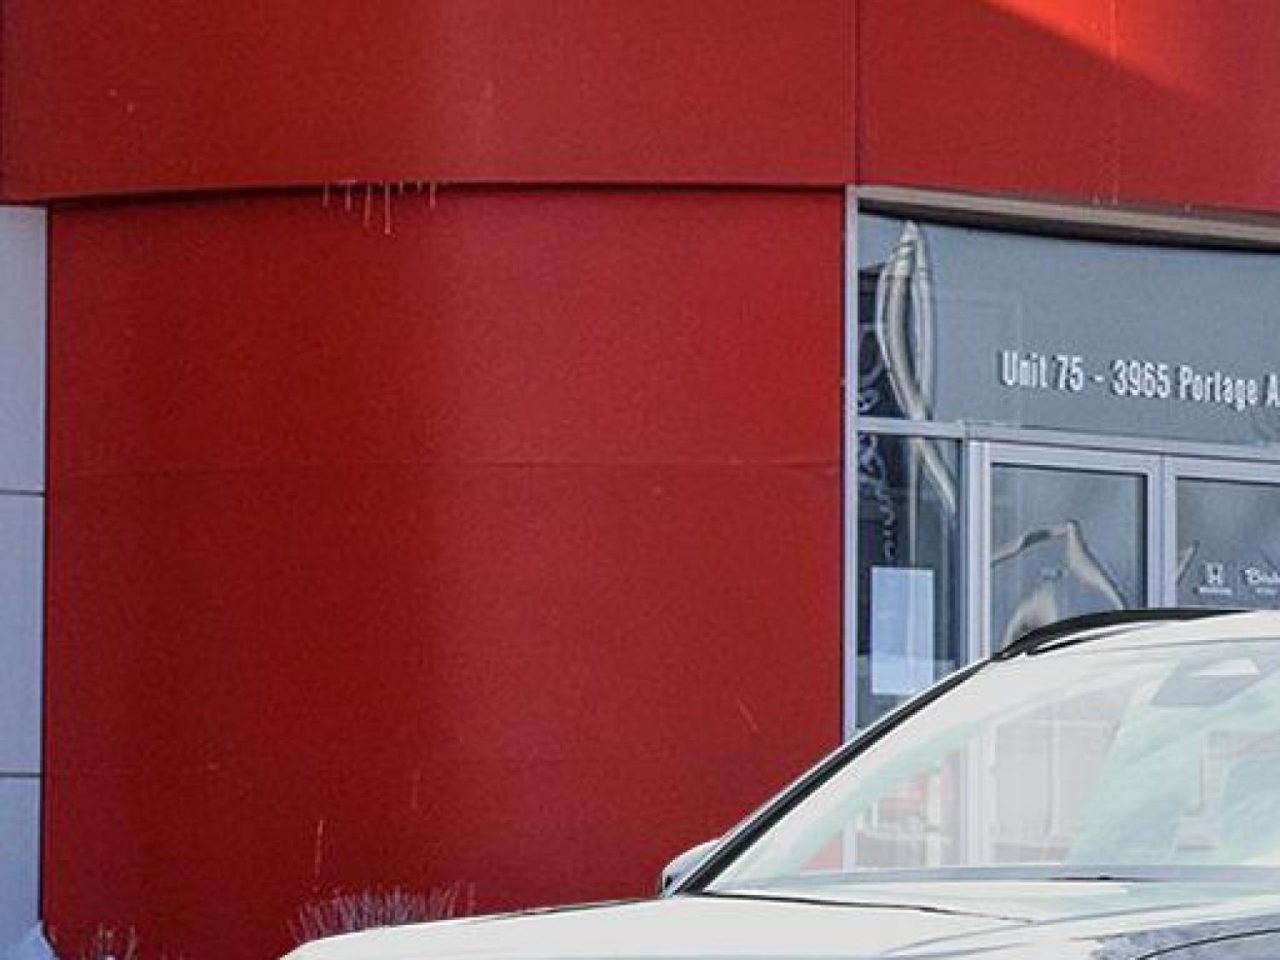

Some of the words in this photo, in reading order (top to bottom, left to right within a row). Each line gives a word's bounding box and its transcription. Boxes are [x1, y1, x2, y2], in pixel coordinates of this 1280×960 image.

[1000, 351, 1047, 388] Unit
[1055, 354, 1084, 391] 75
[1110, 359, 1170, 399] 3965
[1178, 364, 1256, 411] Portage
